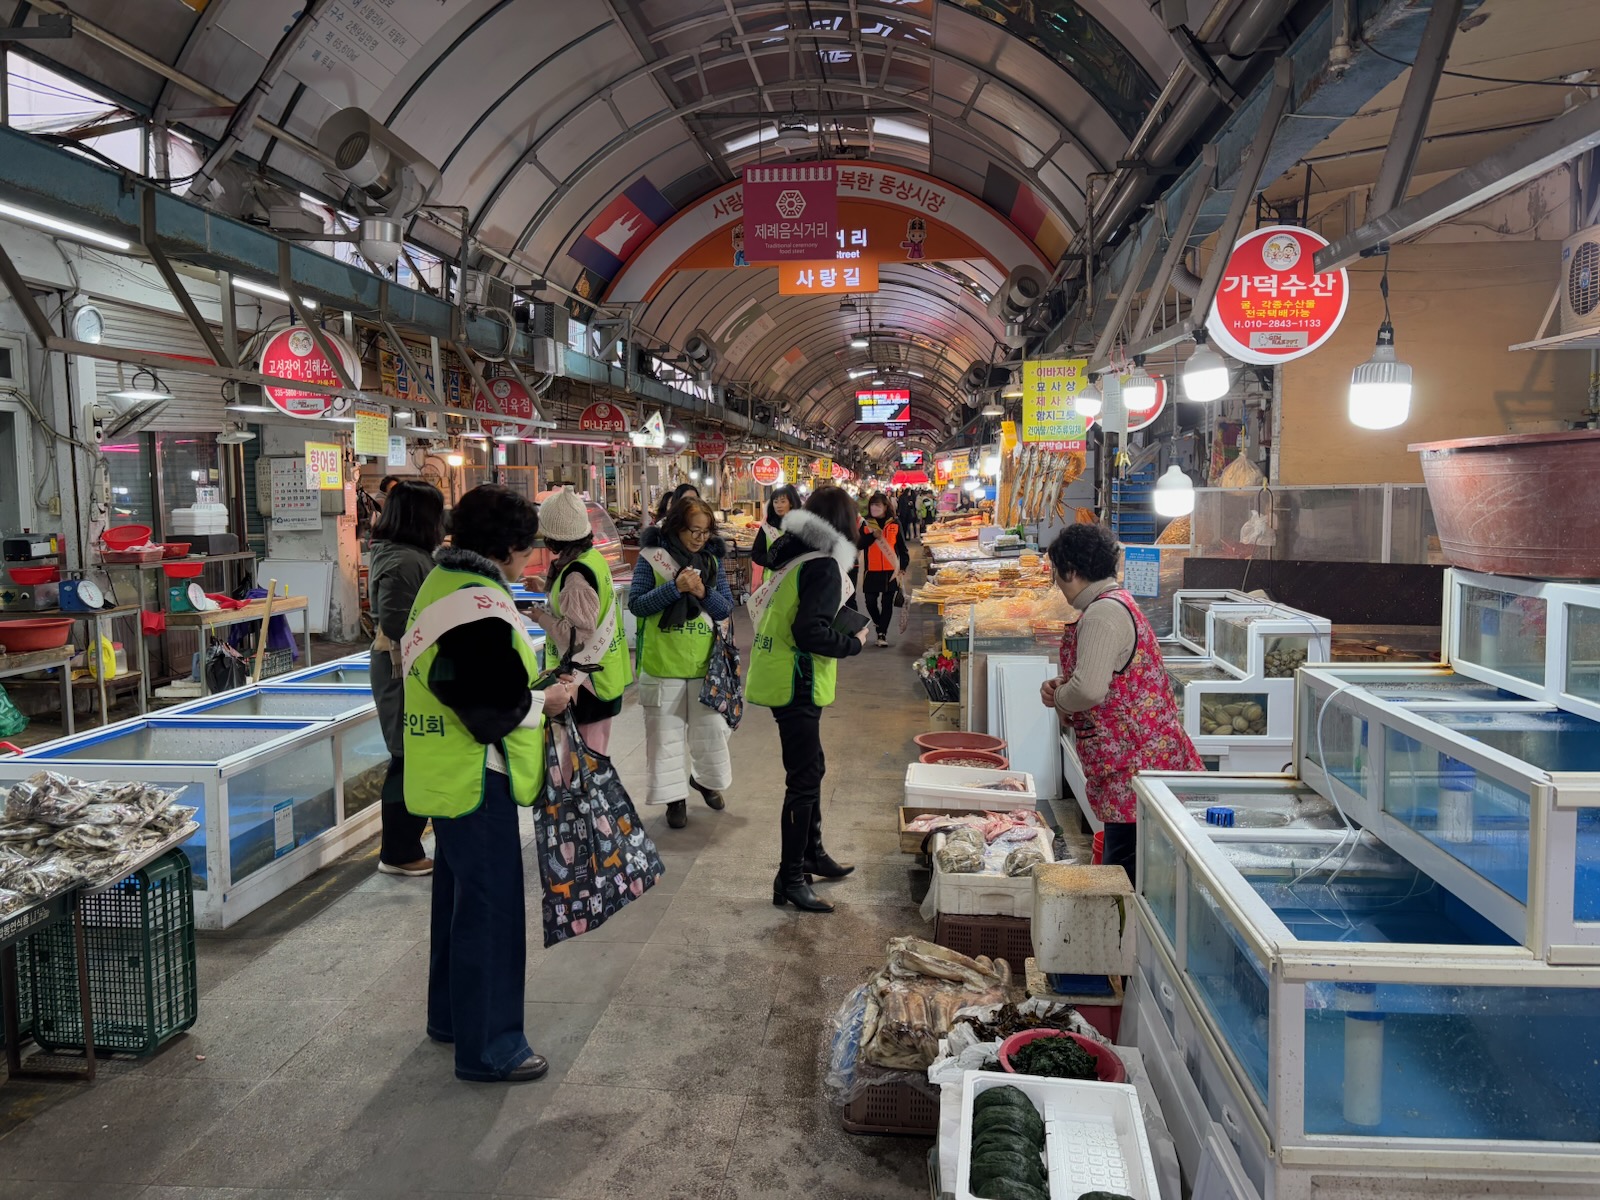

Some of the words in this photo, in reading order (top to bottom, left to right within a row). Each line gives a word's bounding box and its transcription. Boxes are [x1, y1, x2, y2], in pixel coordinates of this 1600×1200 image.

[836, 170, 874, 191] 복한
[878, 174, 947, 213] 동상시장
[754, 221, 829, 240] 제례음식거리
[796, 267, 860, 288] 사랑길
[1223, 273, 1337, 298] 가덕수산
[1262, 299, 1316, 309] 각종수산물
[1245, 308, 1311, 318] 전국택배가능
[1233, 319, 1321, 328] H.010-2843-1133
[1036, 367, 1077, 377] 이바지상
[583, 420, 623, 431] 마나과일
